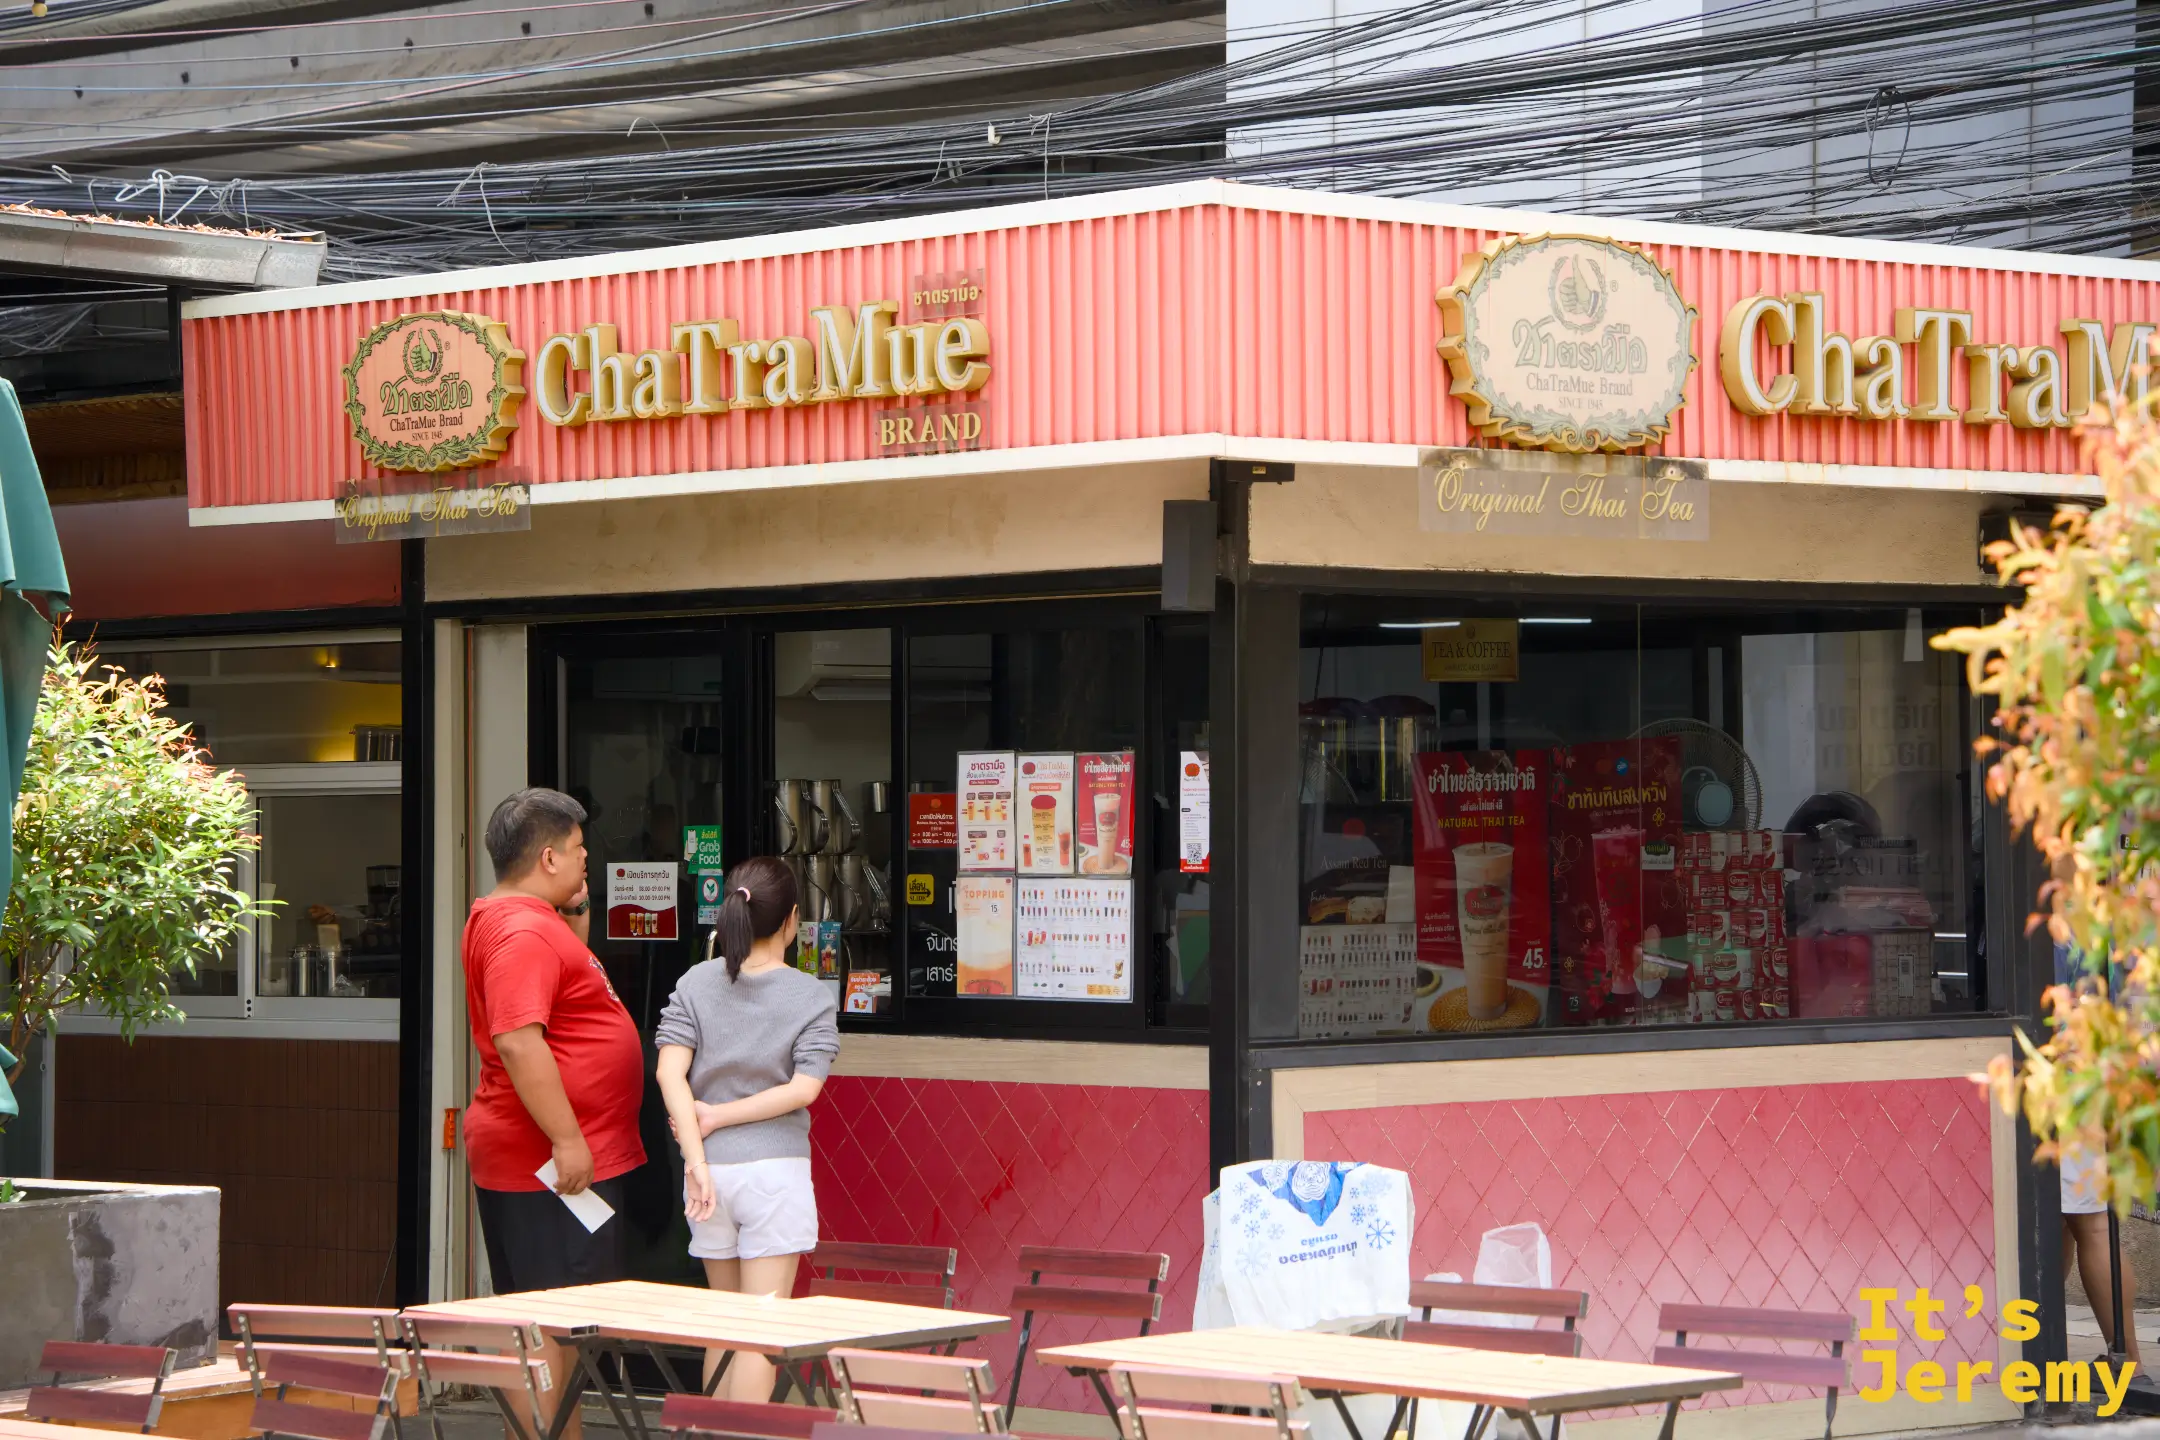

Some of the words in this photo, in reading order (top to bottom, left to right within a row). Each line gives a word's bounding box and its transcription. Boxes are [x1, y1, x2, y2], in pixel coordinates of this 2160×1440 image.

[913, 278, 979, 306] ชาตรามือ
[1512, 315, 1648, 375] ชาตรามือ
[535, 299, 992, 427] ChaTraMue
[1526, 373, 1595, 394] ChaTraMue
[1600, 377, 1633, 396] Brand
[380, 372, 473, 417] ชาตรามือ
[1558, 397, 1583, 409] SINCE
[389, 416, 436, 431] ChaTraMue
[439, 412, 463, 426] Brand
[880, 412, 982, 446] BRAND
[411, 431, 429, 441] SINCE
[1435, 467, 1551, 531] Original
[1560, 473, 1628, 518] Thai
[1641, 476, 1695, 521] Tea
[343, 494, 414, 540] Original
[420, 486, 468, 522] Thai
[477, 481, 518, 517] Tea
[1431, 641, 1454, 659] TEA
[1456, 641, 1465, 658] &
[1466, 641, 1511, 658] COFFEE
[970, 759, 1005, 771] ชาตรามือ
[1437, 817, 1479, 829] NATURAL
[1482, 816, 1505, 828] THAI
[1508, 815, 1525, 826] TEA
[699, 840, 721, 853] Grab
[699, 853, 721, 865] Food
[1321, 856, 1350, 869] Assam
[1352, 856, 1369, 869] Red
[1371, 856, 1387, 869] Tea
[965, 890, 1005, 898] TOPPING
[990, 904, 998, 913] 15
[1569, 996, 1579, 1007] 75
